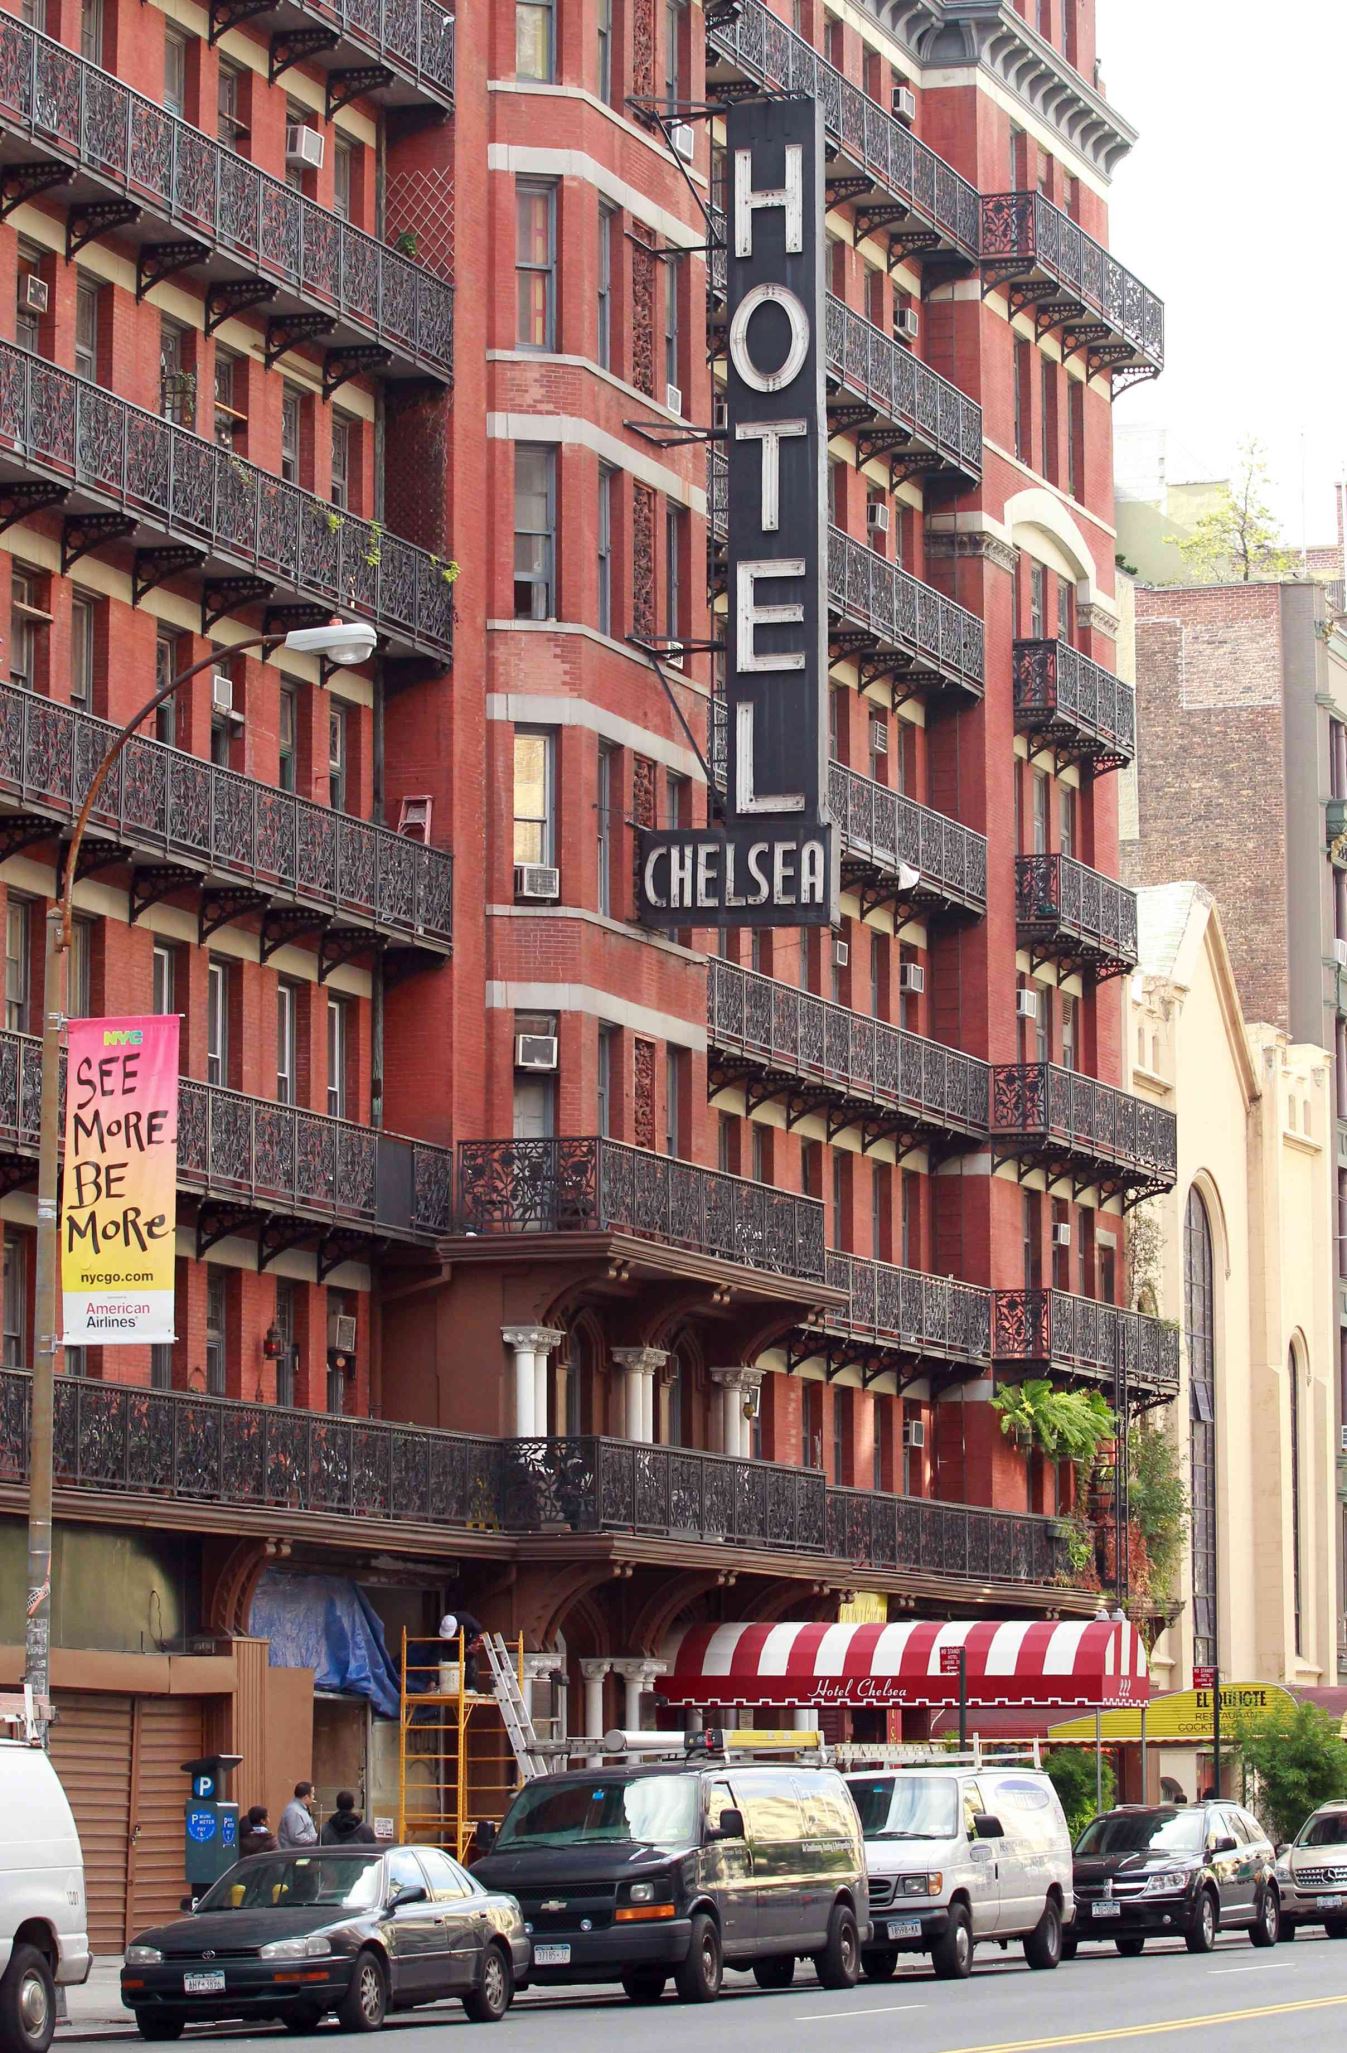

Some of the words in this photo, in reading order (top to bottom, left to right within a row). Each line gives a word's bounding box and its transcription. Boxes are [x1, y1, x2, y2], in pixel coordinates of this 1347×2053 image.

[729, 144, 811, 814] HOTEL
[644, 840, 825, 908] CHELSEA
[103, 1030, 143, 1046] NYC
[77, 1052, 140, 1110] SEE
[68, 1160, 129, 1210] BE
[81, 1272, 154, 1285] nycgo.com
[86, 1302, 150, 1315] American
[86, 1316, 136, 1328] Airlines
[807, 1678, 854, 1697] Hotel
[857, 1678, 907, 1697] Chelsea
[1196, 1692, 1209, 1707] EL
[199, 1776, 212, 1796] P
[192, 1814, 198, 1824] P
